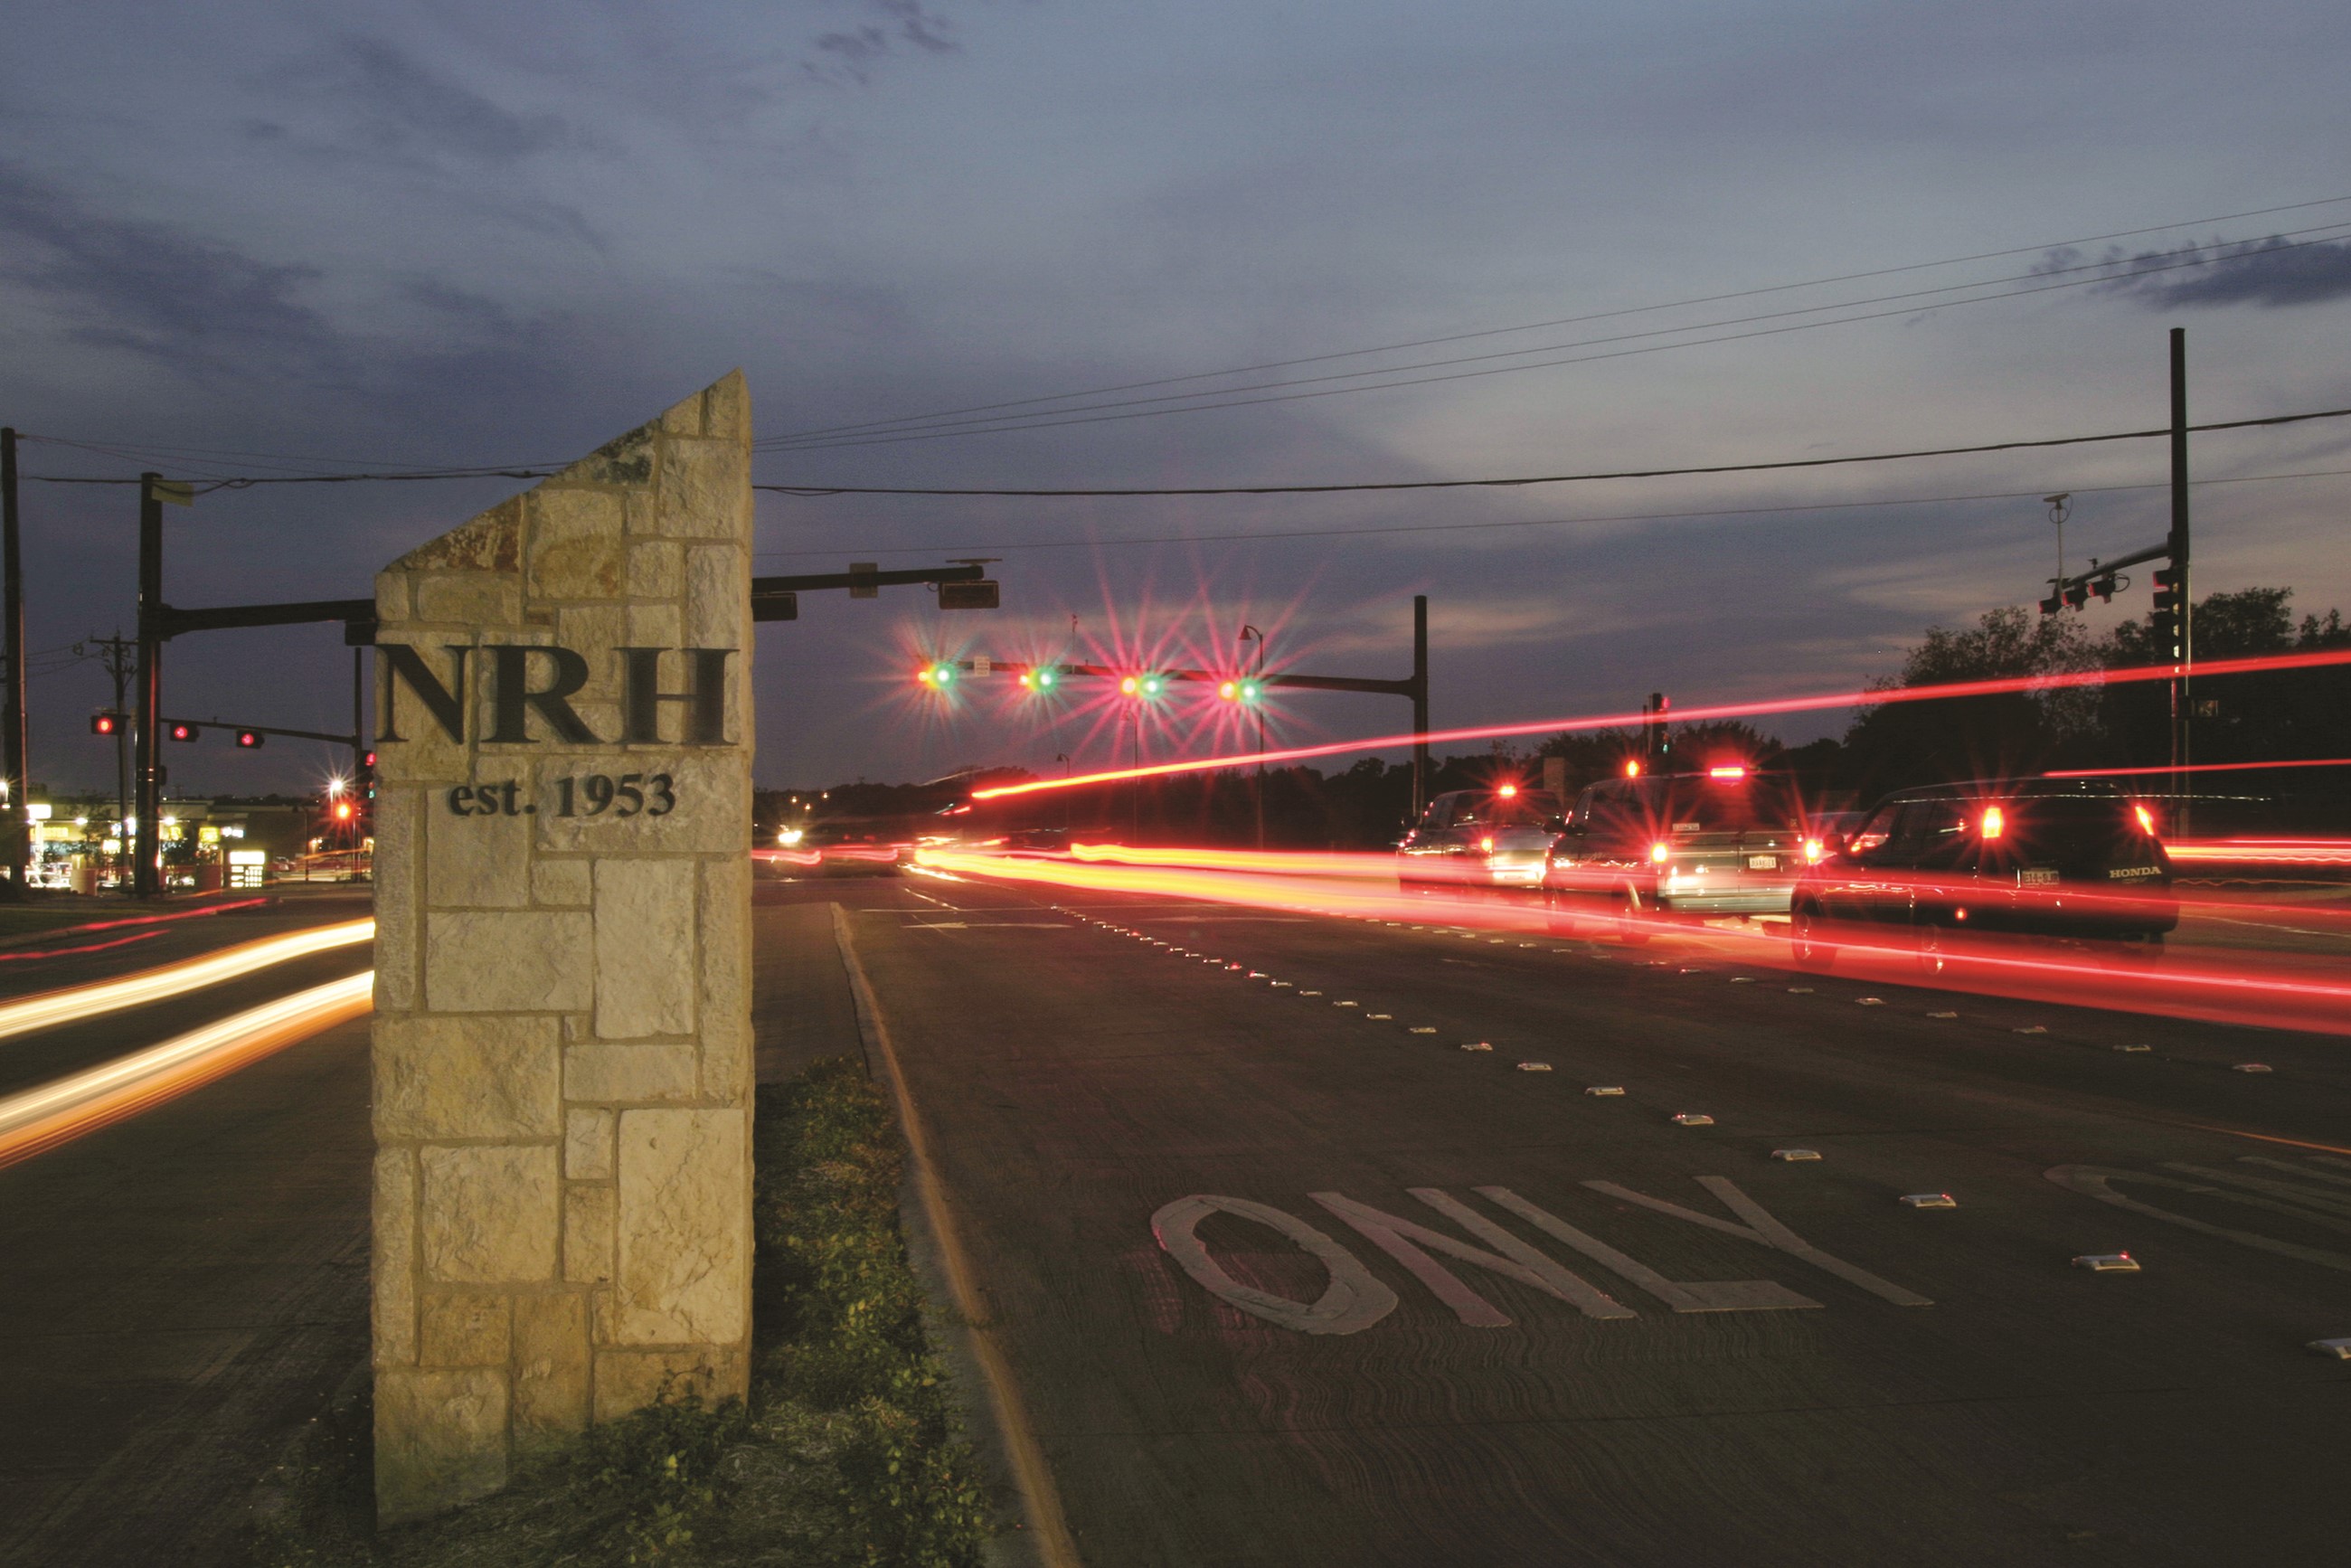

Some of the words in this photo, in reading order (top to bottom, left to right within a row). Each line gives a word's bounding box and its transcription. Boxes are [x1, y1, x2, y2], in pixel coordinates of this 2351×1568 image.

[374, 643, 741, 746] NRH
[449, 778, 537, 817] est.
[554, 773, 676, 817] 1953
[2109, 866, 2162, 878] HONDA
[1150, 1176, 1935, 1336] ONLY
